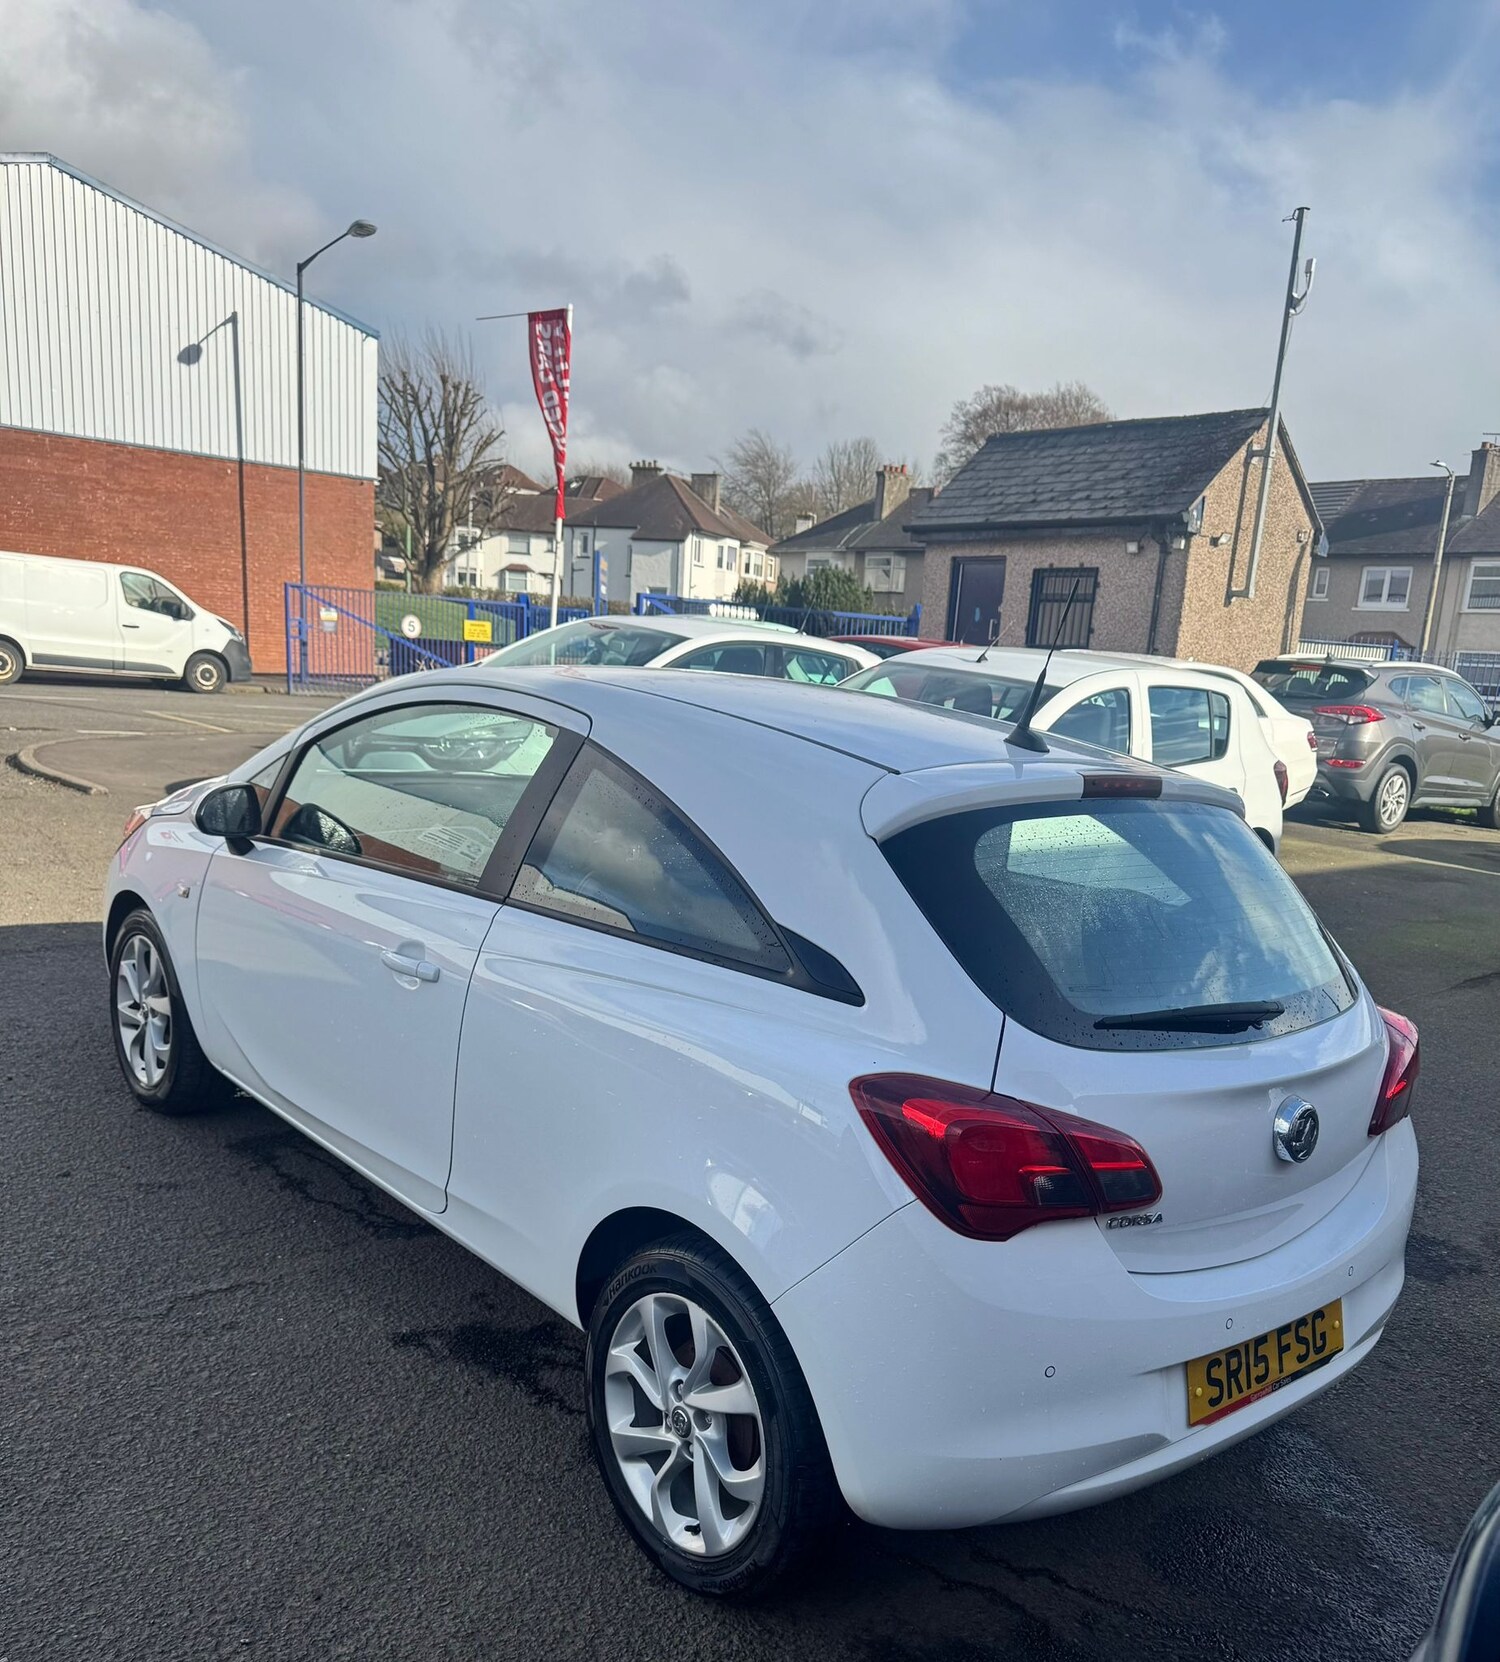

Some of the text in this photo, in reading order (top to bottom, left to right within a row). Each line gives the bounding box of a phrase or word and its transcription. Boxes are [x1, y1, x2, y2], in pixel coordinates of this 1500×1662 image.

[408, 620, 416, 632] 5
[1106, 1211, 1163, 1230] CORSA
[1206, 1309, 1327, 1408] SR15 FSG
